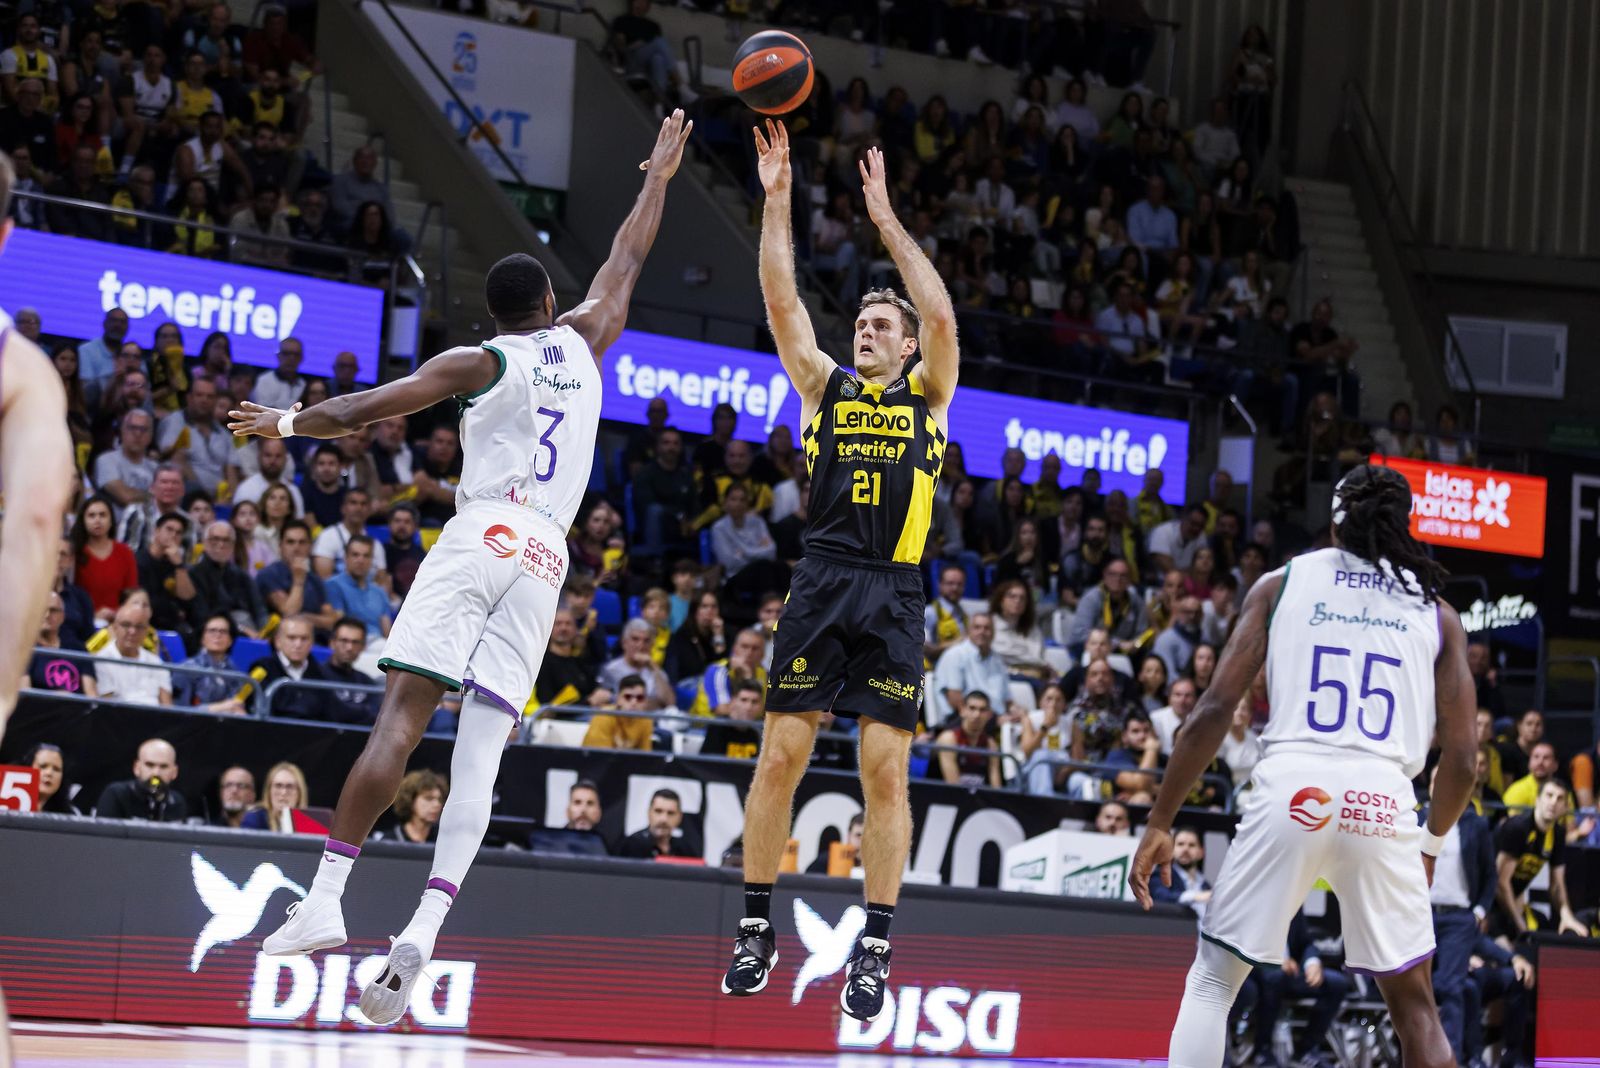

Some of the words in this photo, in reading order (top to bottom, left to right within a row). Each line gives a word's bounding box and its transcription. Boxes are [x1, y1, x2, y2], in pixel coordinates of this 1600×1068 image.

[98, 270, 303, 345] tenerife!
[615, 354, 789, 434] tenerife!
[835, 407, 911, 431] Lenovo
[533, 406, 565, 482] 3
[838, 440, 906, 464] tenerife!
[1005, 417, 1168, 476] tenerife!
[852, 469, 881, 505] 21
[1425, 469, 1474, 500] Islas
[1411, 493, 1473, 522] narias
[523, 548, 544, 568] DEL
[527, 537, 563, 570] COSTA
[1334, 570, 1395, 595] PERRY
[788, 675, 820, 683] LAGUNA
[868, 678, 901, 696] Canarias
[1307, 645, 1402, 741] 55
[1344, 790, 1400, 813] COSTA
[1341, 808, 1371, 822] DEL
[1375, 811, 1394, 827] SO
